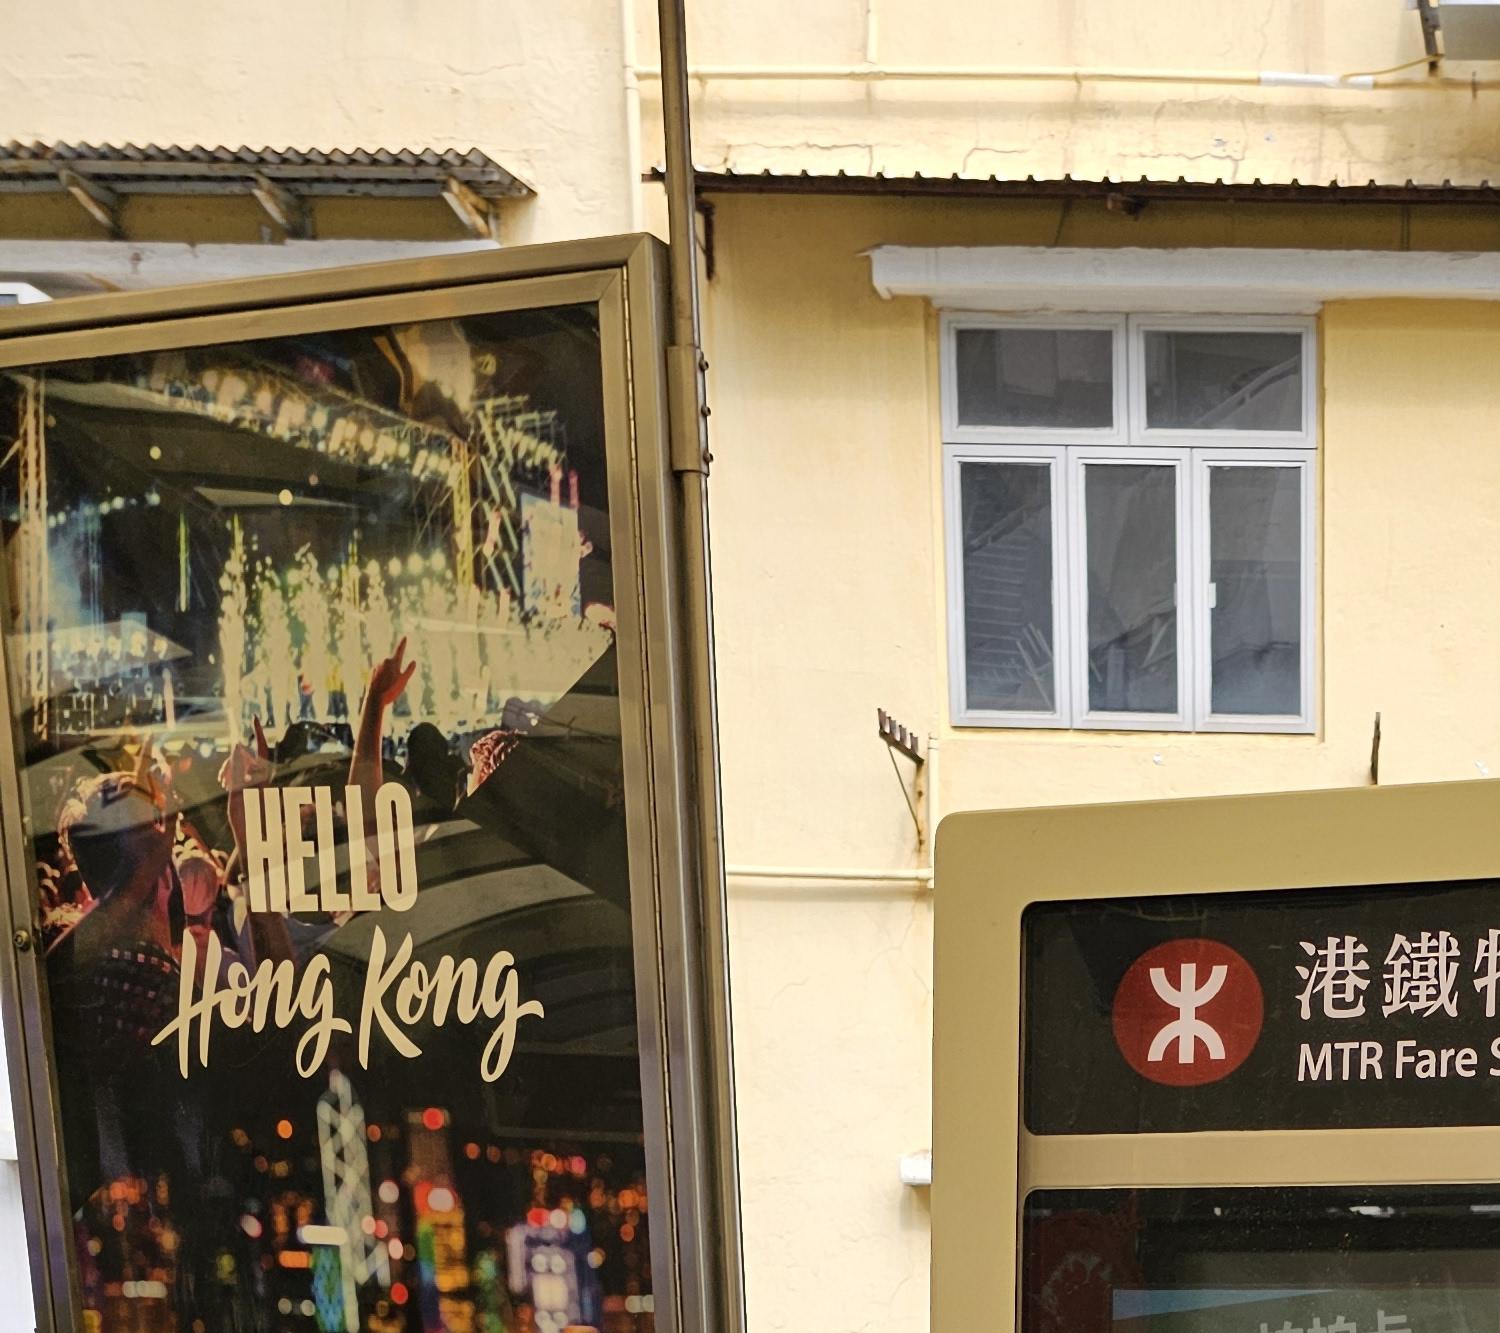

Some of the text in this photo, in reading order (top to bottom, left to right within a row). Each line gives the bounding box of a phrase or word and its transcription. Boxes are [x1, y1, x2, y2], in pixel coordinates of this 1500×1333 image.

[243, 782, 418, 912] HELLO
[151, 925, 545, 1082] Hong Kong
[1297, 1040, 1383, 1082] MTR
[1395, 1039, 1479, 1079] Fare
